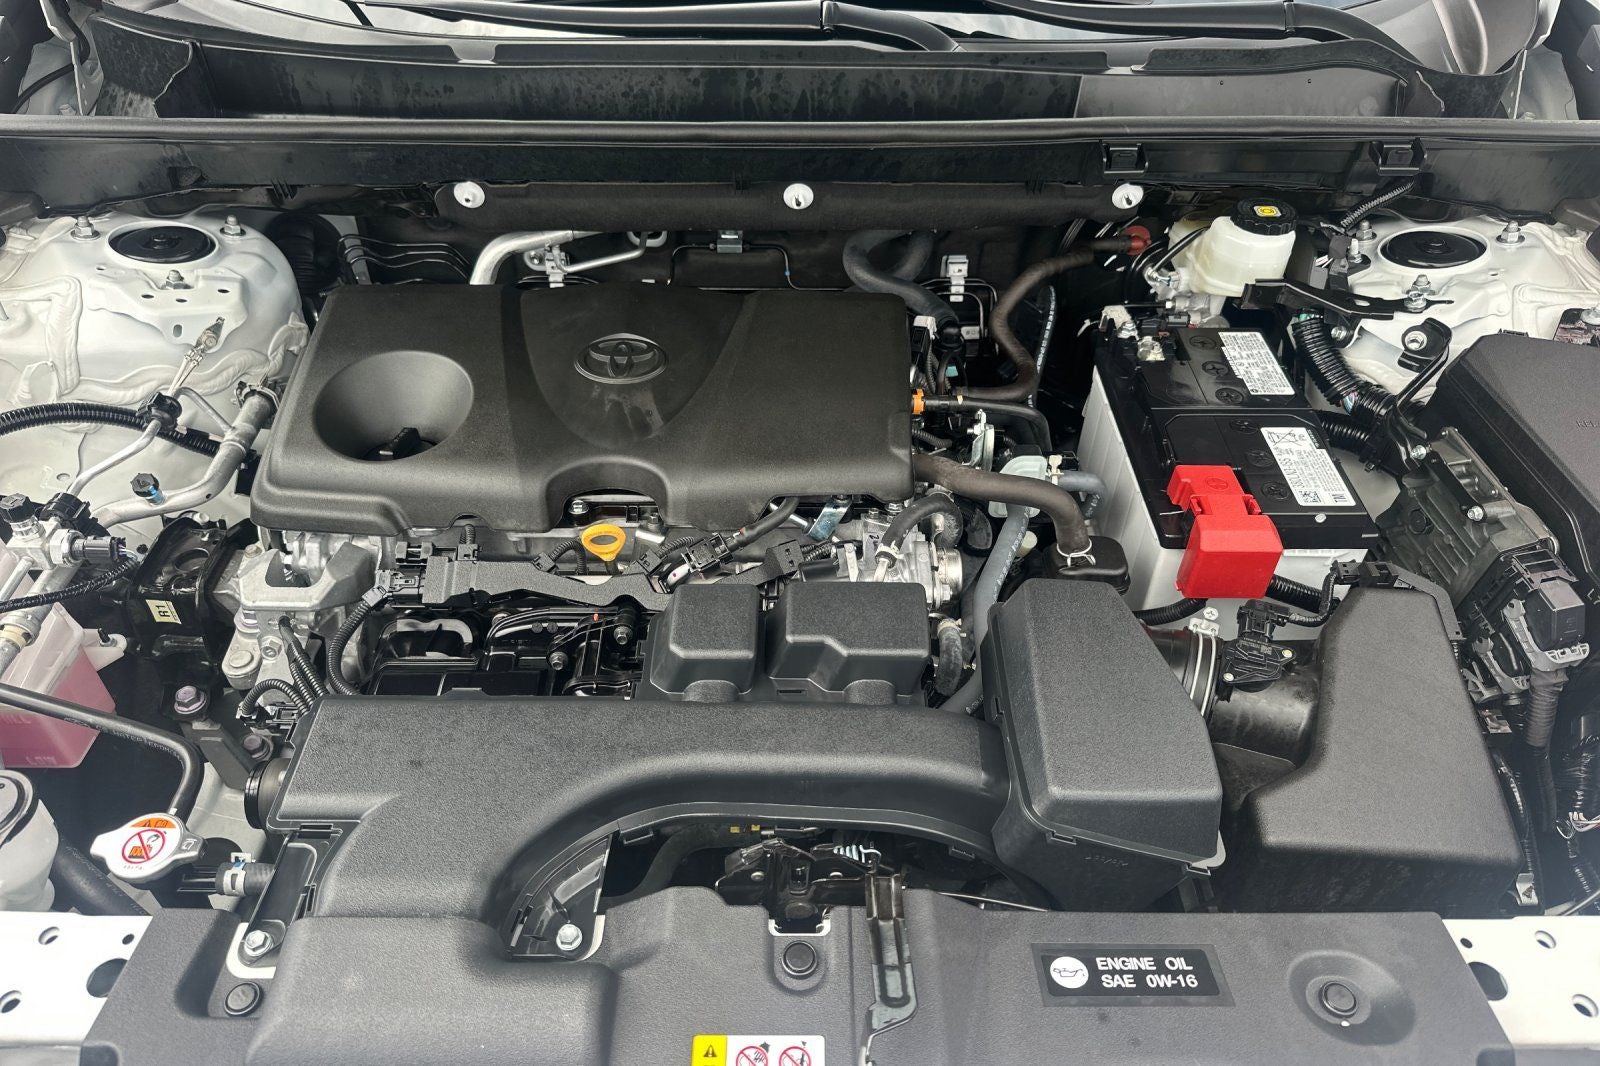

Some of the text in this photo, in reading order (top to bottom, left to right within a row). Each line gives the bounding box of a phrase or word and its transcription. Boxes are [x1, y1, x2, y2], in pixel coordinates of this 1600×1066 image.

[1095, 957, 1193, 971] ENGINE OIL
[1101, 974, 1198, 988] SAE 0W-16
